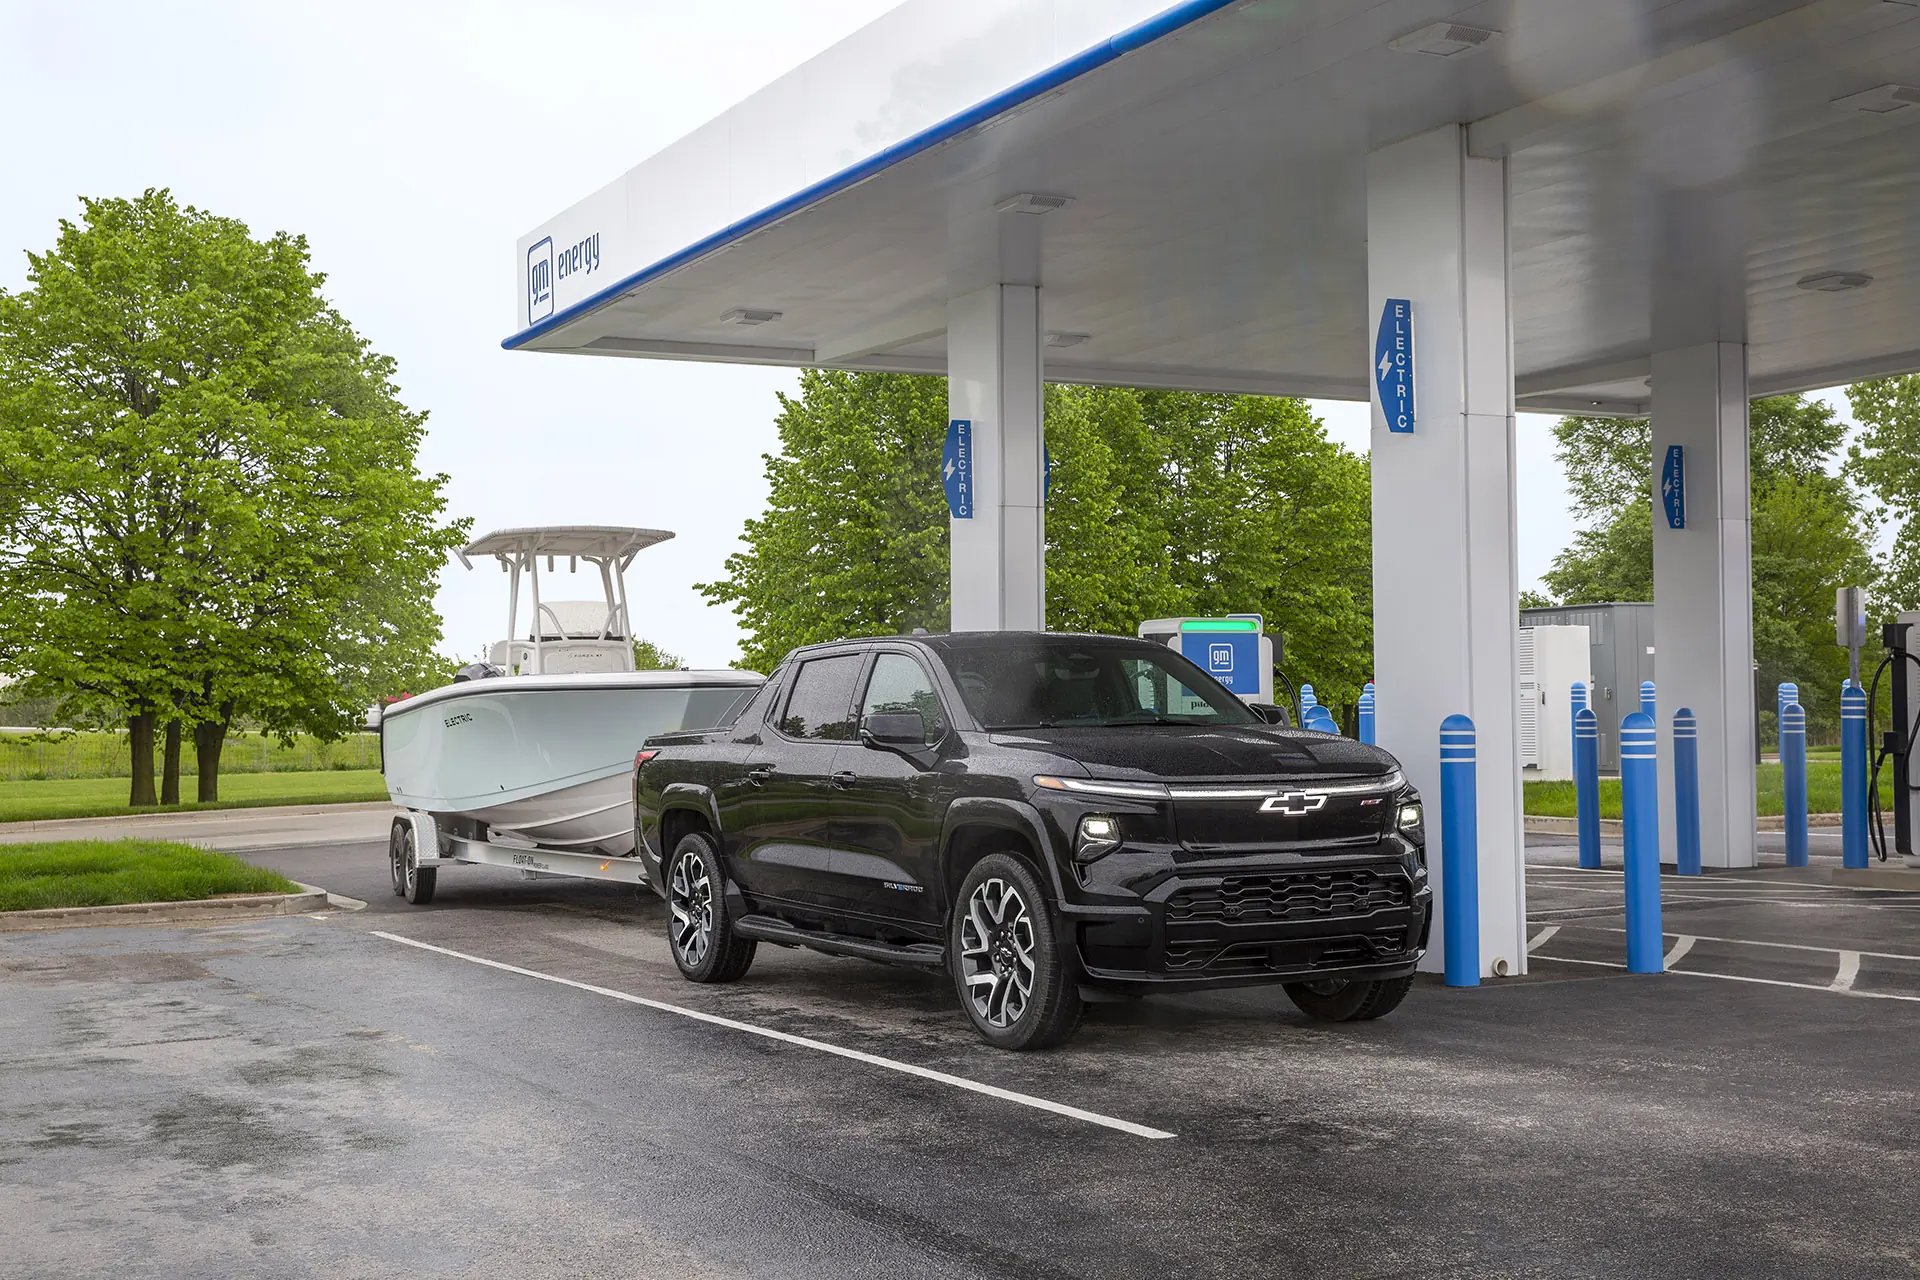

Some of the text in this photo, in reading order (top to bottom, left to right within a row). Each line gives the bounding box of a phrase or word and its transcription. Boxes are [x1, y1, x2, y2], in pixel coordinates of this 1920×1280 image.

[532, 232, 600, 306] gm energy
[1395, 304, 1408, 428] ELECTRIC
[957, 424, 967, 516] ELECTRIC
[1673, 448, 1681, 526] ELECTRIC
[1213, 650, 1229, 665] gm
[1212, 676, 1234, 685] nergy
[444, 713, 473, 728] ELECTRIC
[1190, 701, 1210, 711] pilo
